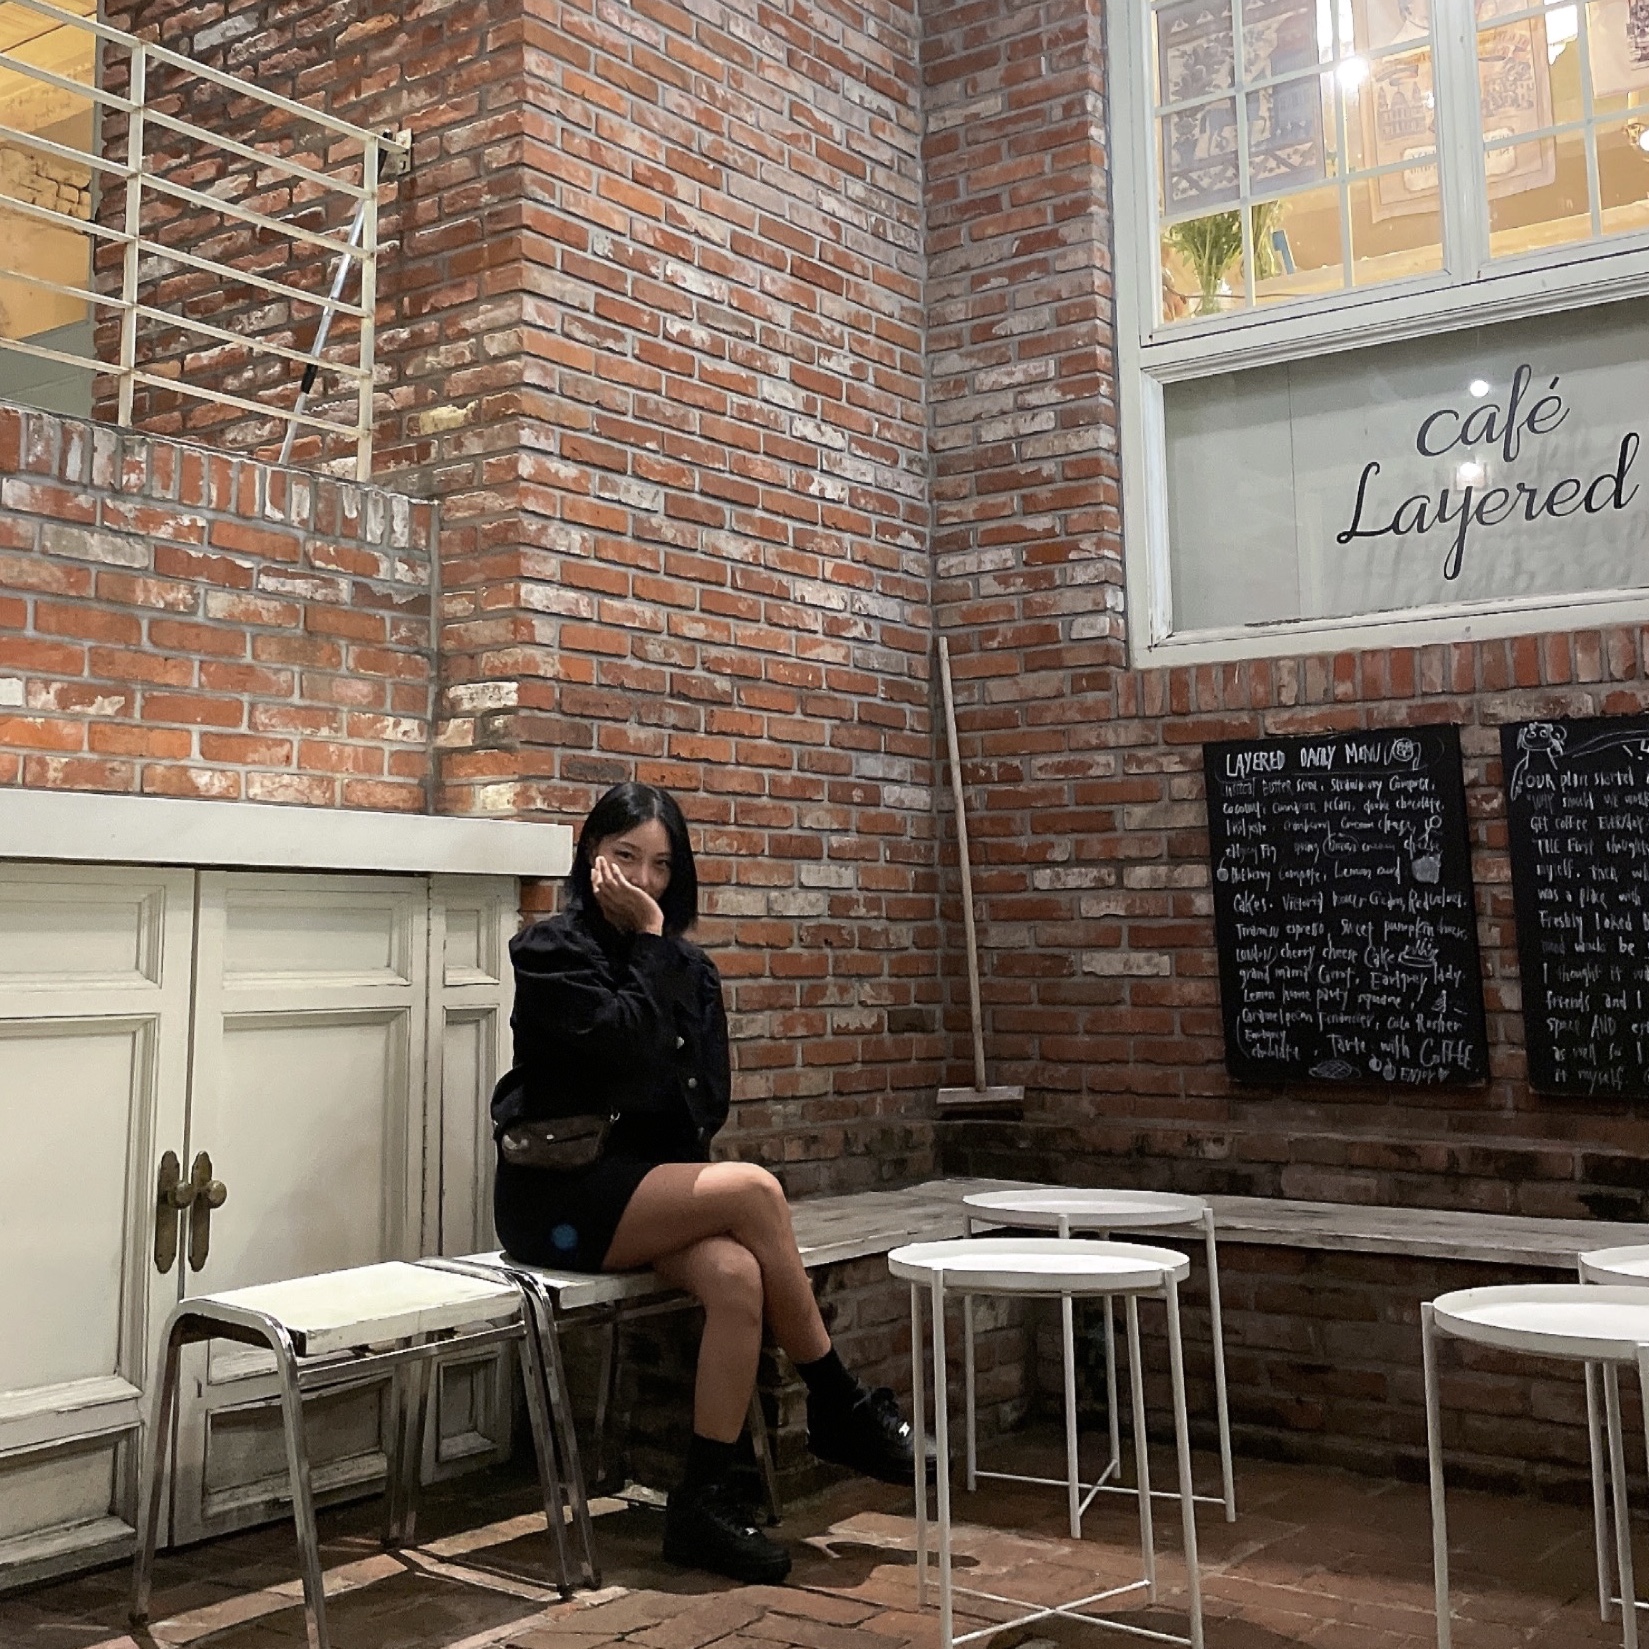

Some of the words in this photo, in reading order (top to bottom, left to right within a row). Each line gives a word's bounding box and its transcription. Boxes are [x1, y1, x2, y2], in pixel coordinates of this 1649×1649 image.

[1416, 363, 1571, 463] café
[1336, 432, 1641, 581] Layered
[1226, 750, 1285, 778] LAYERED
[1300, 745, 1336, 770] DAILY
[1345, 742, 1381, 765] MENU
